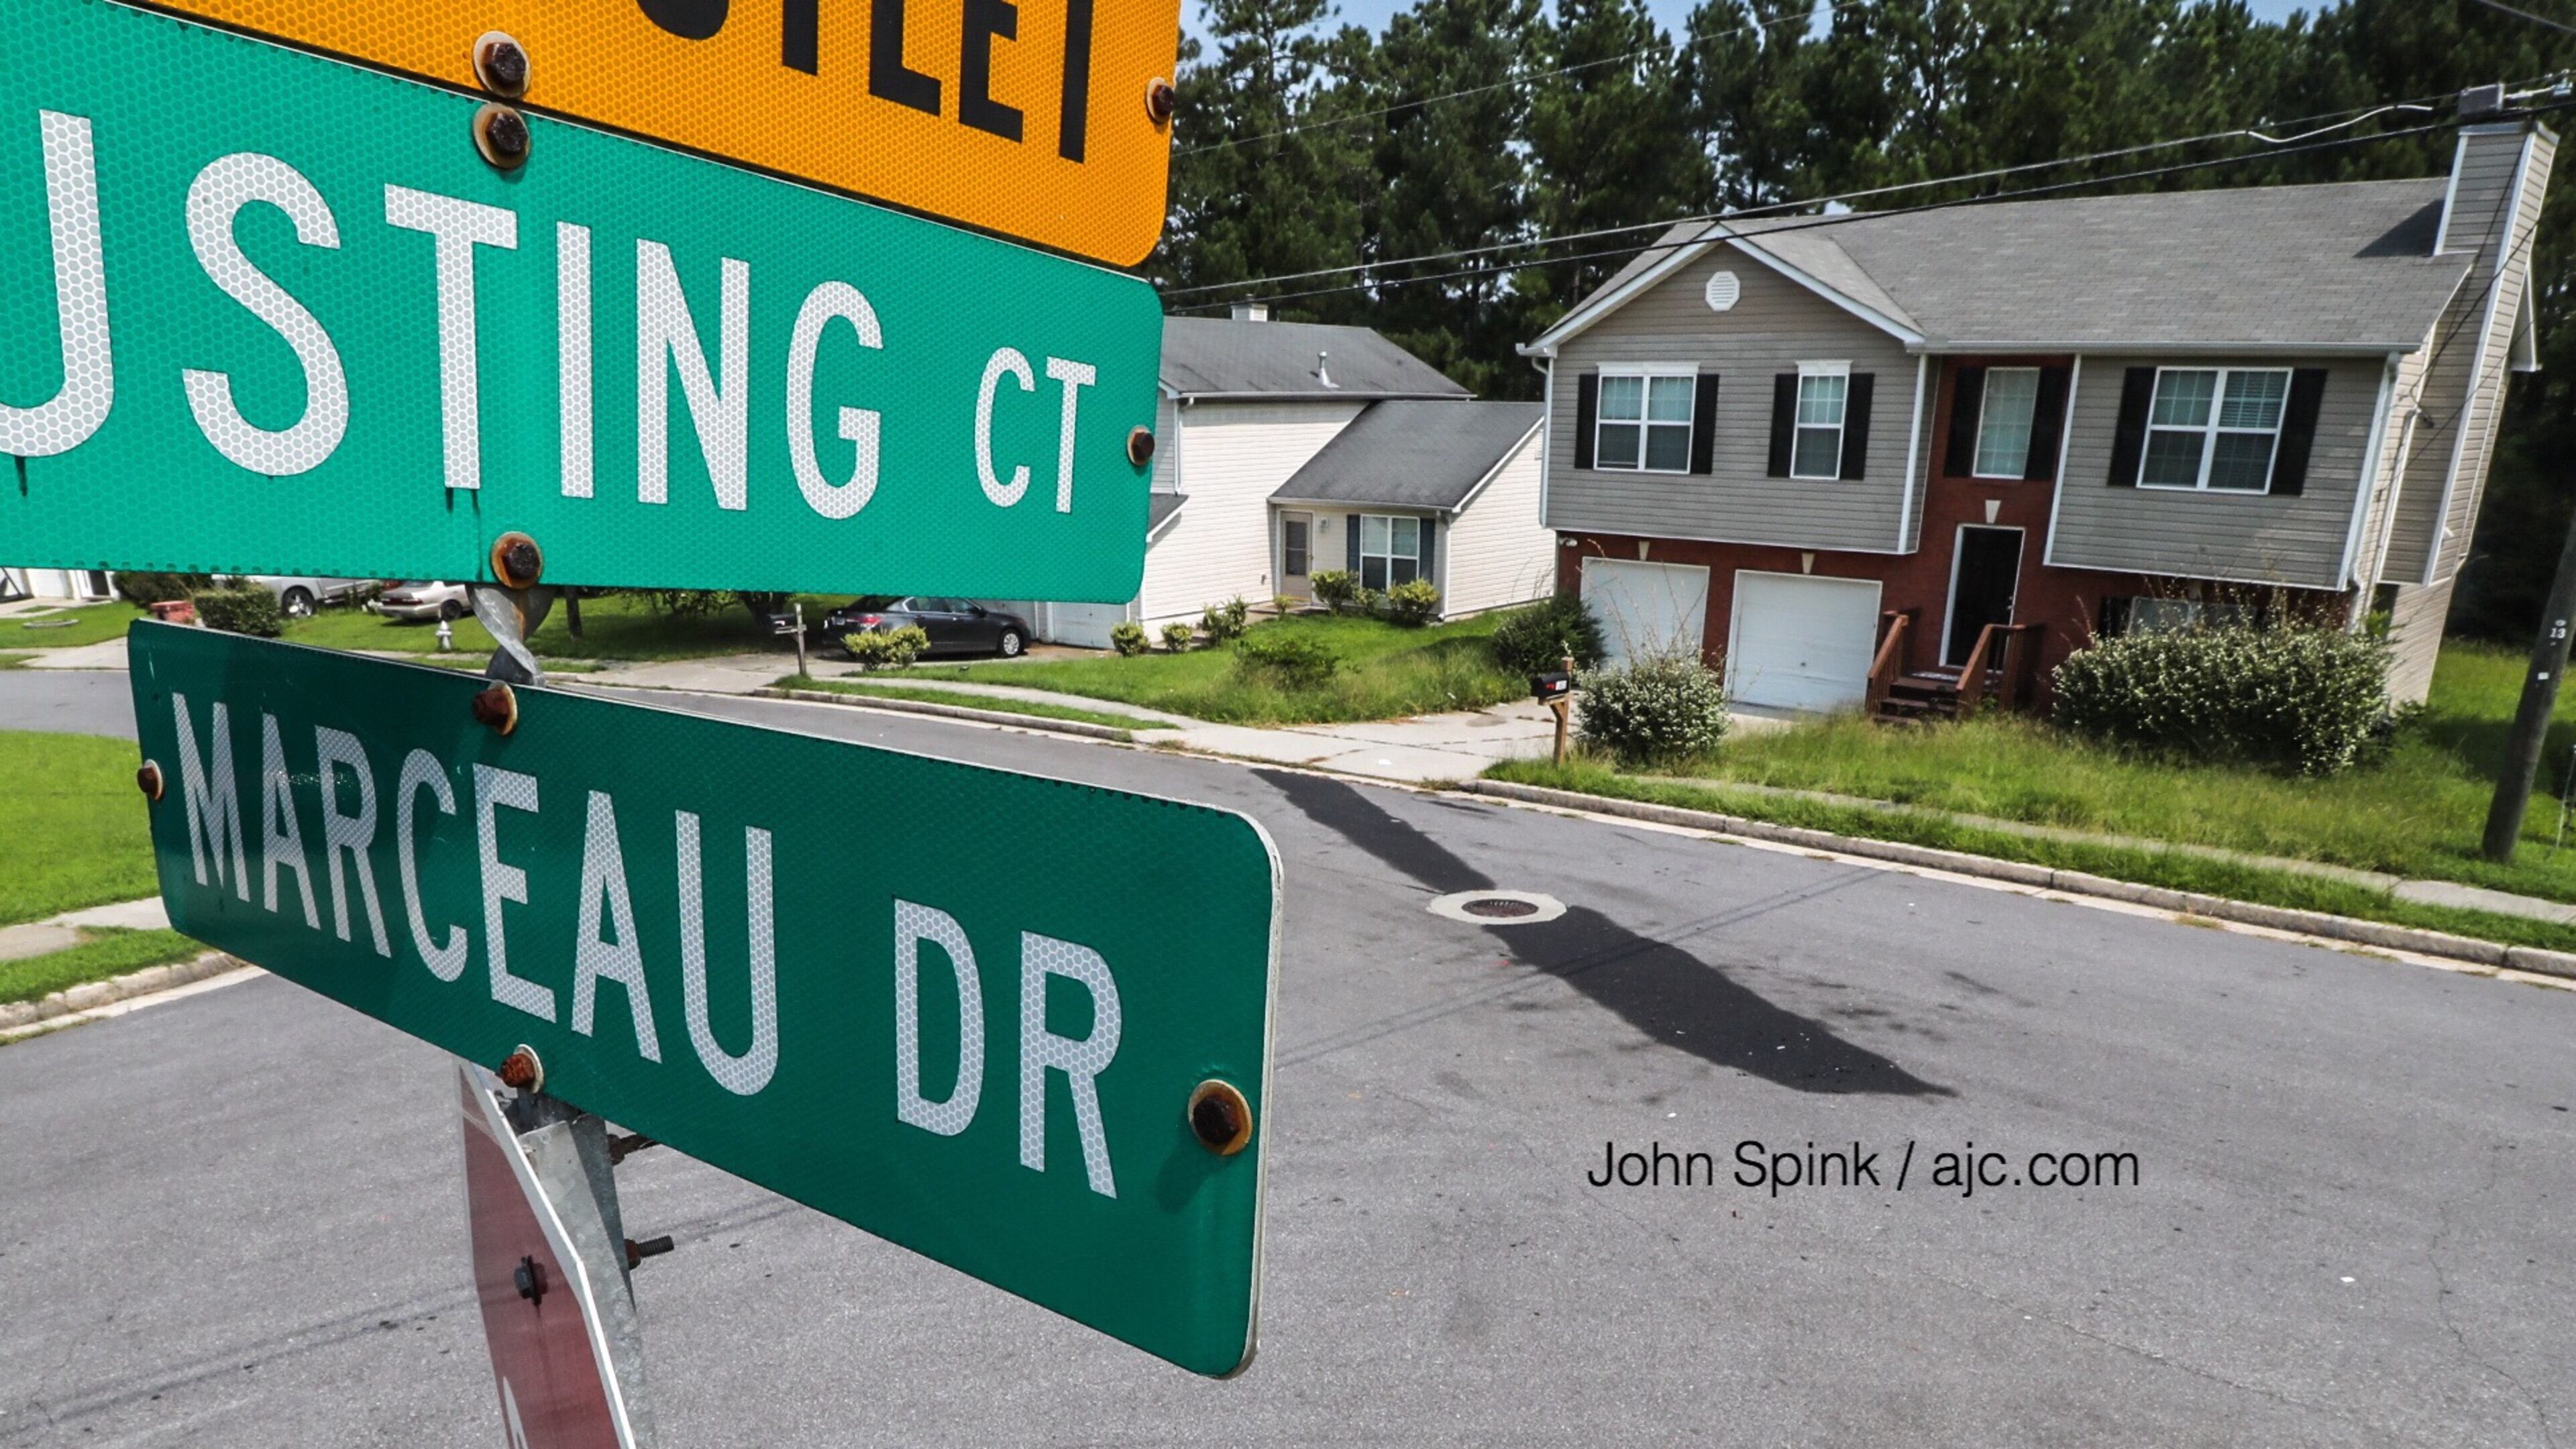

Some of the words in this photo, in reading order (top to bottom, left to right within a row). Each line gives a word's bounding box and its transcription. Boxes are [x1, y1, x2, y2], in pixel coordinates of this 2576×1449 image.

[974, 346, 1097, 515] CT
[172, 692, 779, 1097] MARCEAU
[894, 898, 1122, 1199] DR
